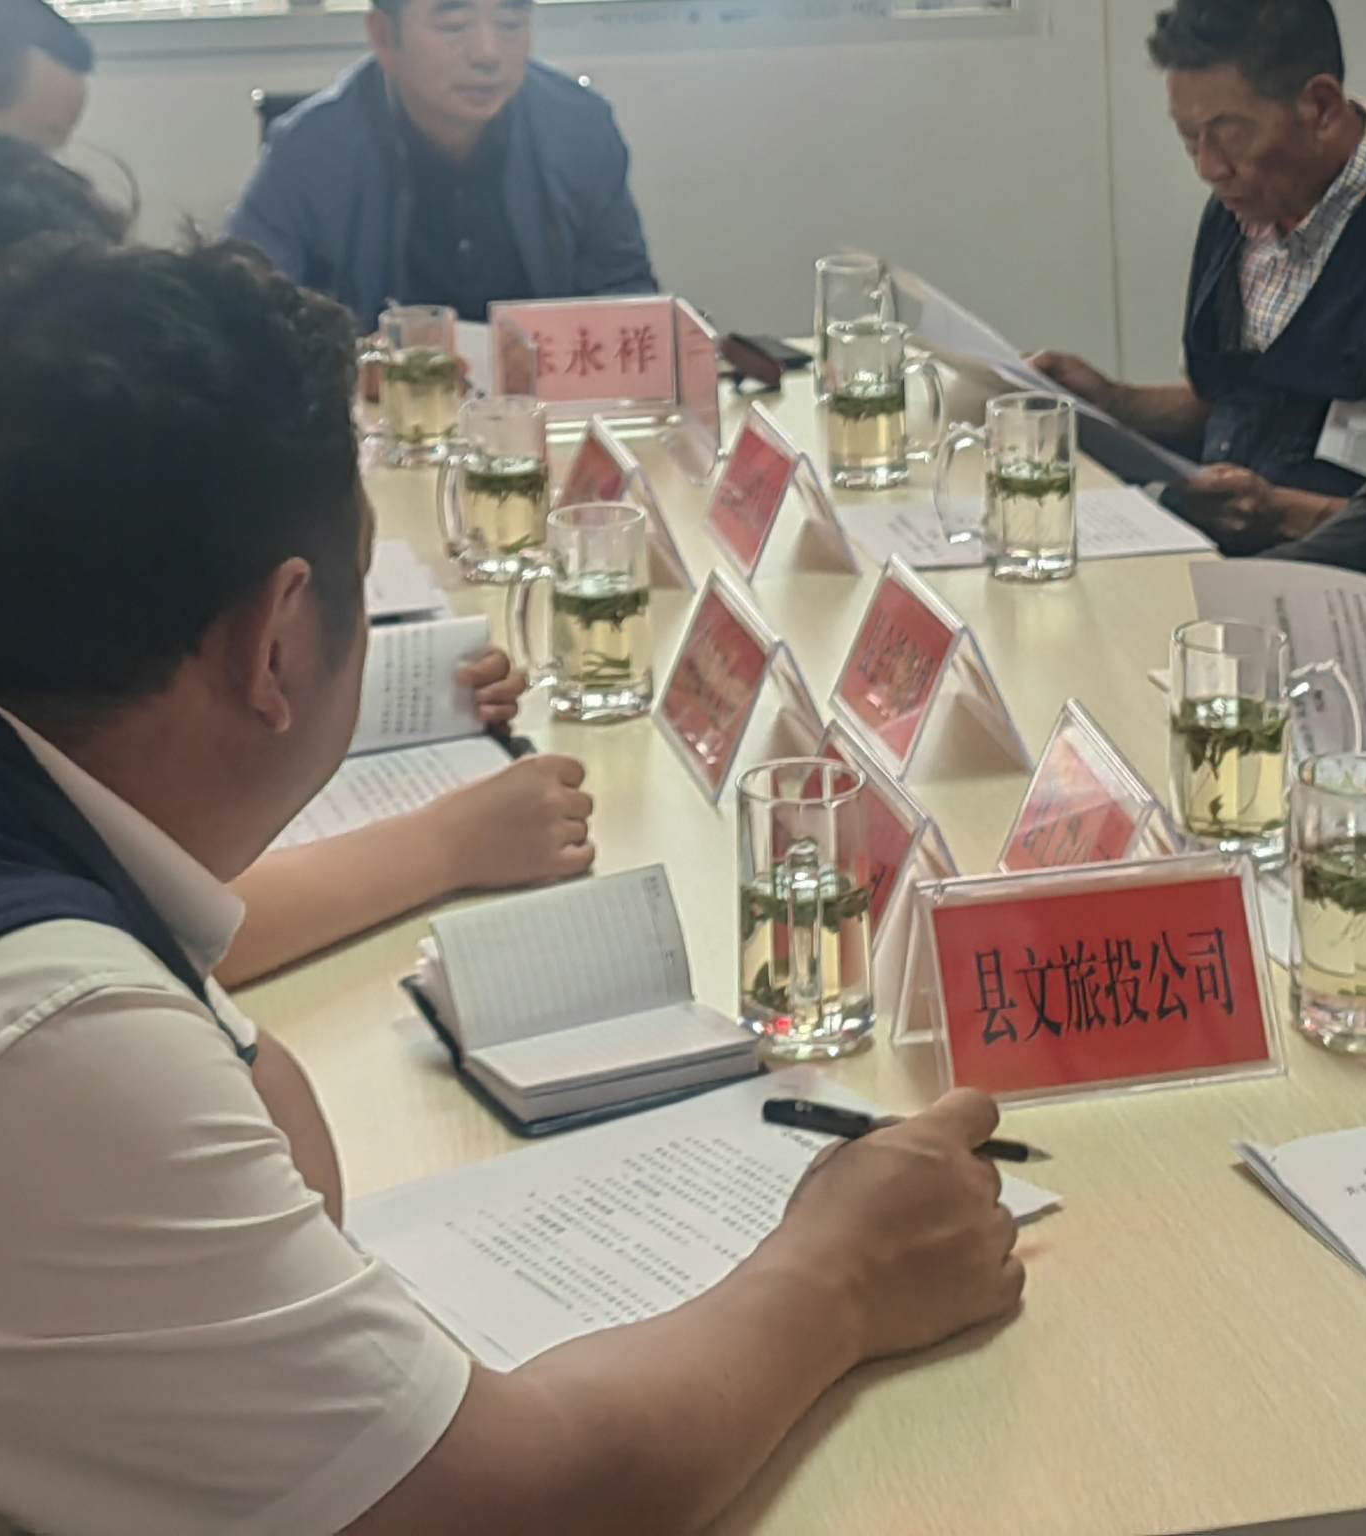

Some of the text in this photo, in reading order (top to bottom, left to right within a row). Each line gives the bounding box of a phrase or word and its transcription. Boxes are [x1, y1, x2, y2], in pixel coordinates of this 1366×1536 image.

[973, 926, 1236, 1047] 县文旅投公司
